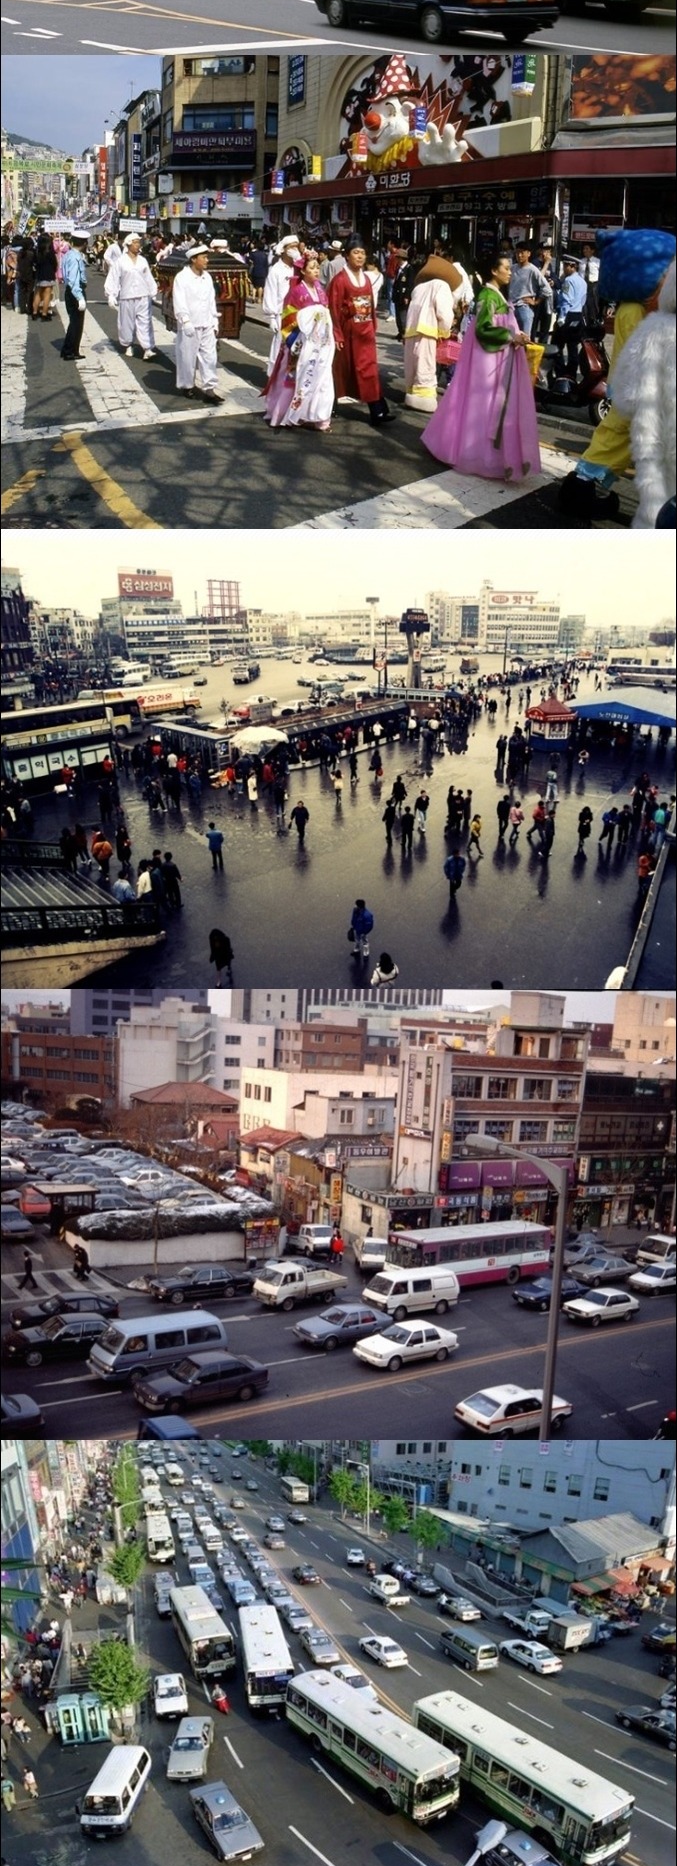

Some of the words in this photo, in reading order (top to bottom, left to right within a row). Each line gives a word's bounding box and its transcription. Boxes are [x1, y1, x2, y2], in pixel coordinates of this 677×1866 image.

[379, 172, 411, 188] 미화당
[134, 580, 172, 592] 삼성전자
[147, 693, 173, 703] 오리온
